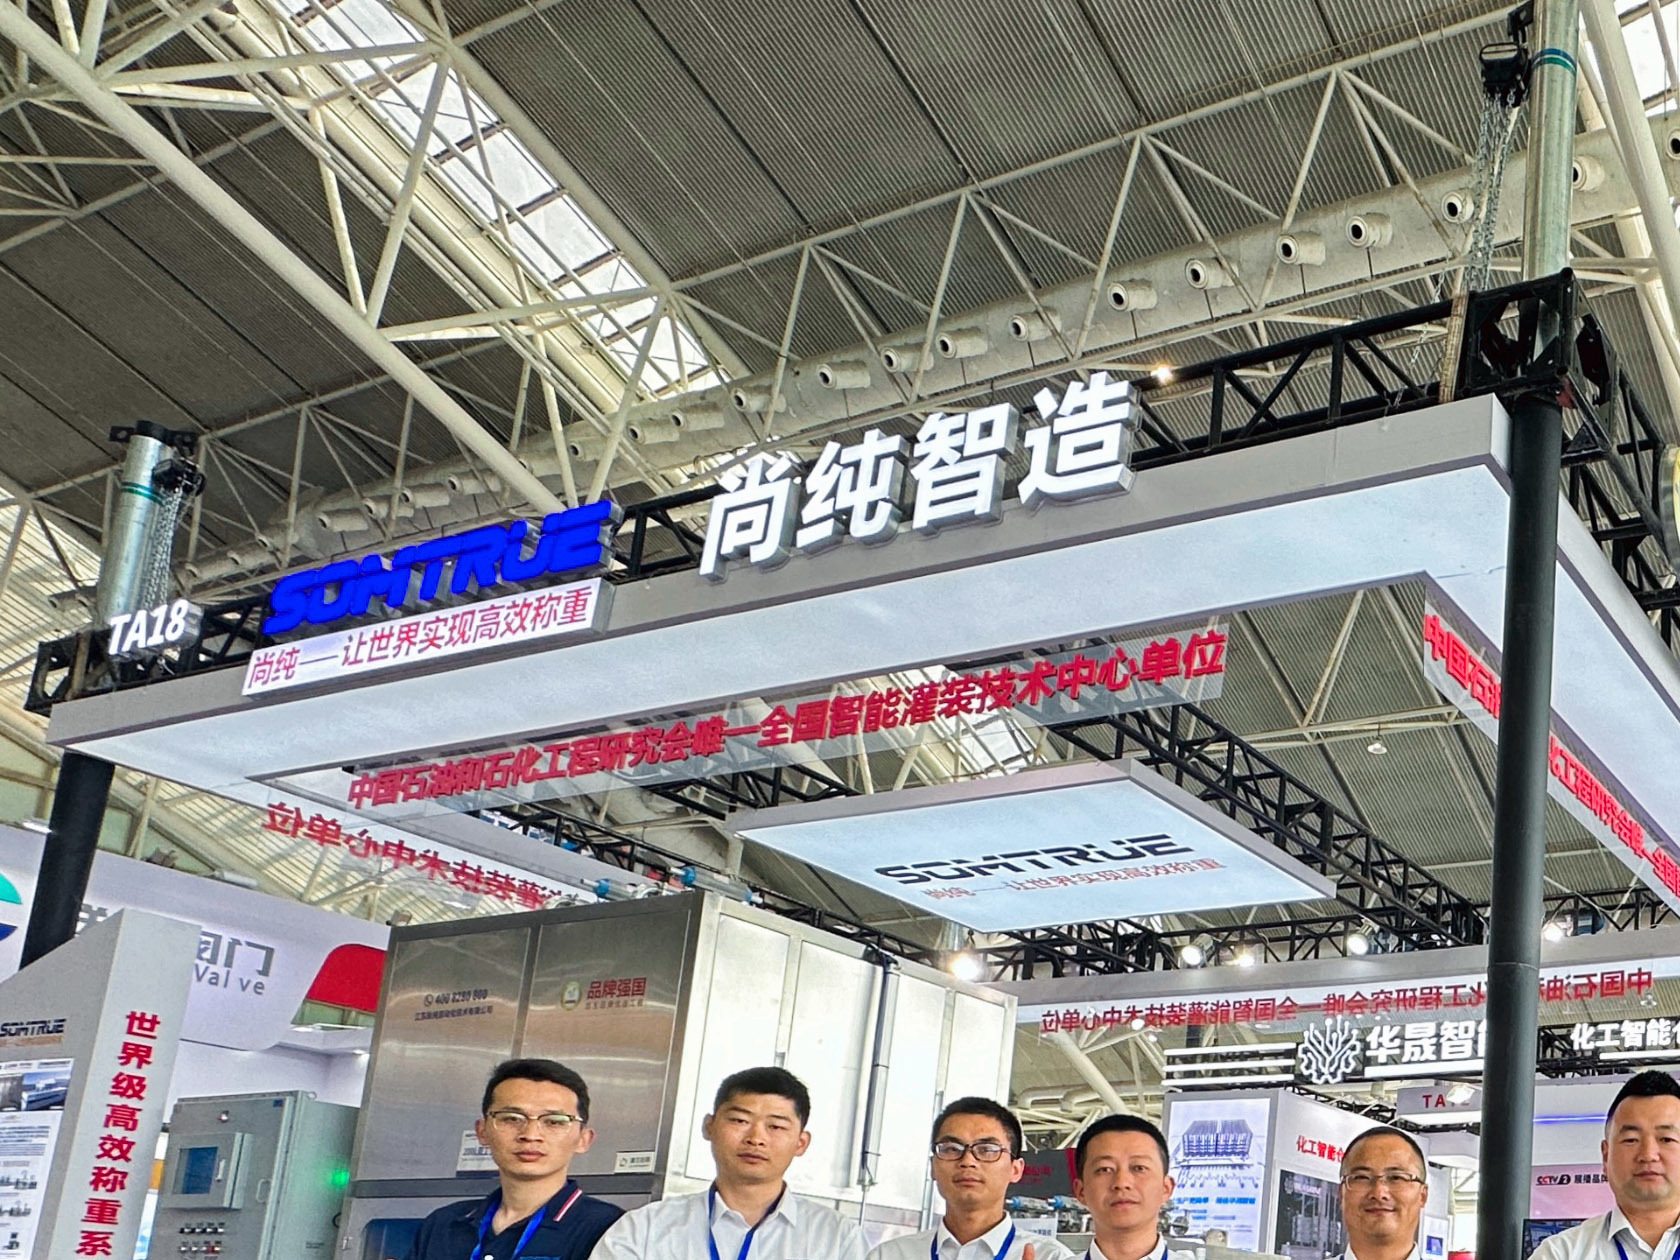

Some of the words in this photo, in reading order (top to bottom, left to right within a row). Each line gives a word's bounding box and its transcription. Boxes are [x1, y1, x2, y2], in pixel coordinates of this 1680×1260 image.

[698, 372, 1134, 577] 尚纯智造
[108, 603, 190, 655] TA18
[263, 500, 613, 634] SOMTRUE
[347, 630, 1228, 810] 中国石油和石化工程研究会唯一全国智能灌装技术中心单位
[875, 834, 1195, 885] SOMTRUE
